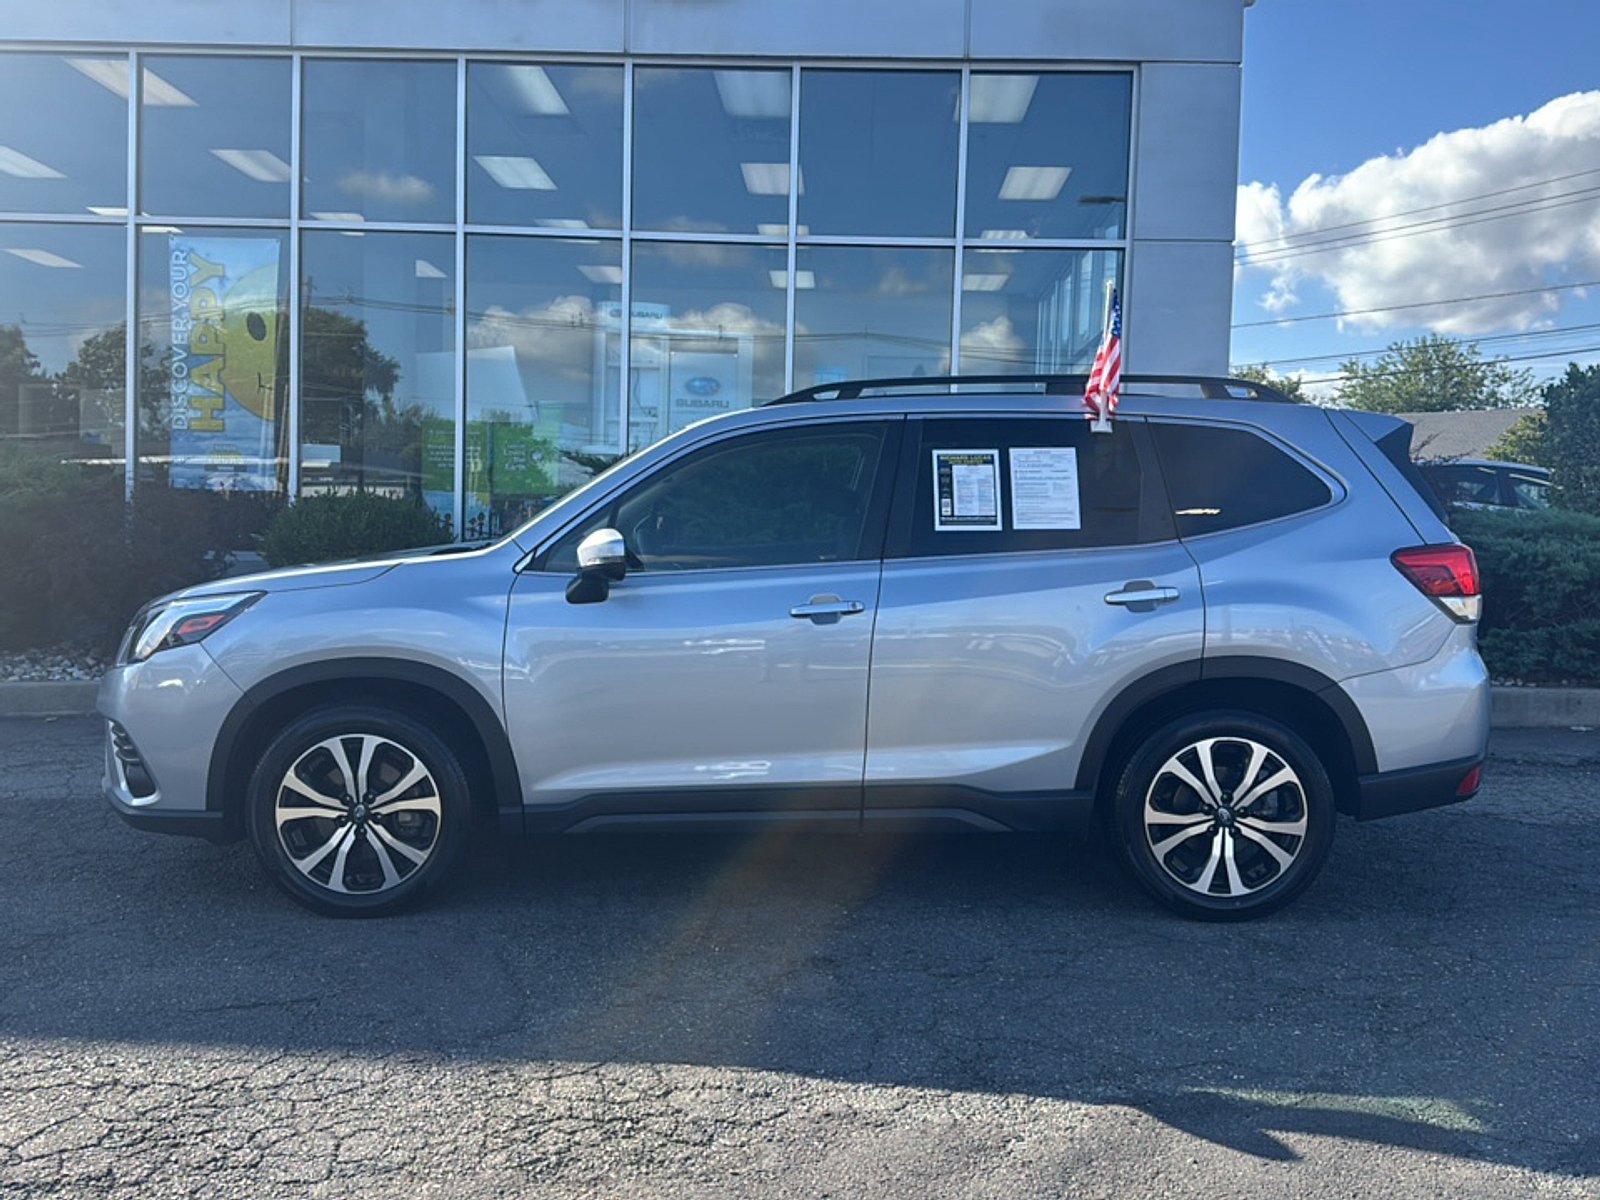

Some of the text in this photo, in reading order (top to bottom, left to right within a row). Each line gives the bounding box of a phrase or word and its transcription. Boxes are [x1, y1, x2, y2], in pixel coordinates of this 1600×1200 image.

[172, 250, 188, 430] DISCOVER YOUR
[190, 252, 225, 432] HAPPY
[675, 399, 730, 408] SUBARU
